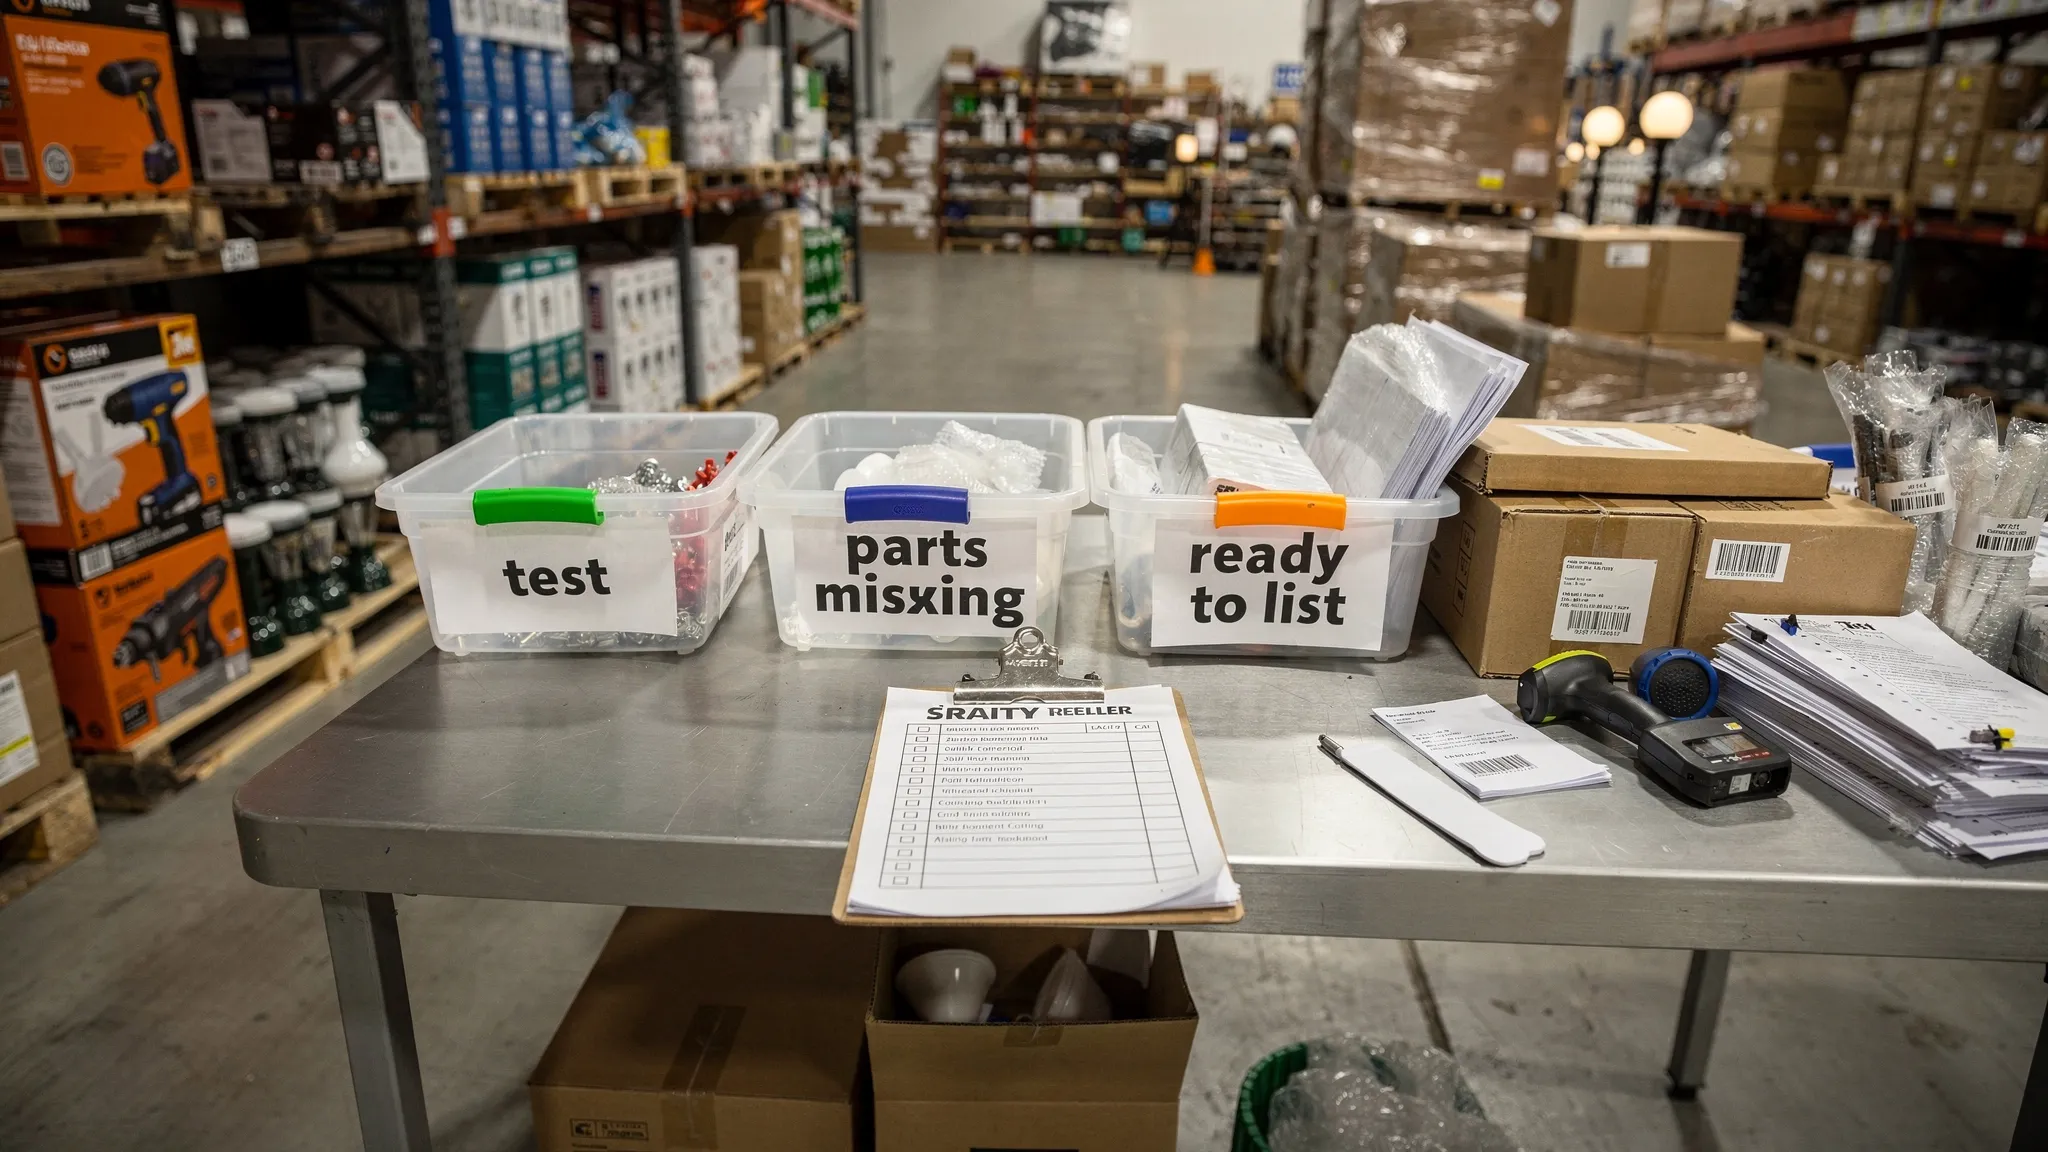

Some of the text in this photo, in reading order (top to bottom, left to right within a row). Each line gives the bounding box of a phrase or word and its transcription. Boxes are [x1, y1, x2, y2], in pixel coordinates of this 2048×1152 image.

[847, 530, 988, 575] parts
[1190, 532, 1349, 585] ready
[503, 559, 611, 596] test
[815, 573, 1025, 628] misxing
[1190, 581, 1346, 625] to list
[1048, 706, 1132, 717] REELLER
